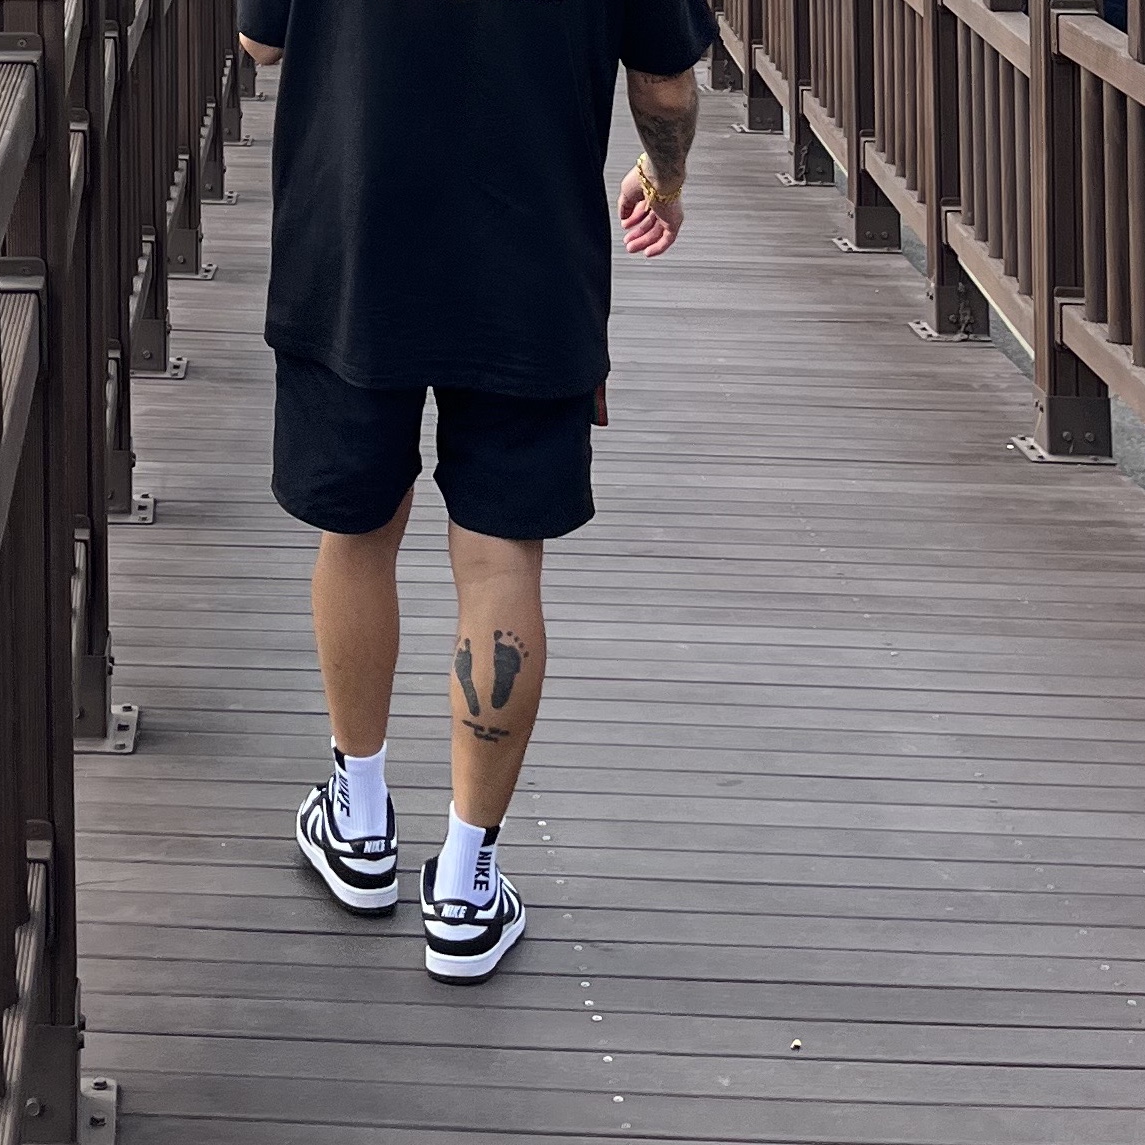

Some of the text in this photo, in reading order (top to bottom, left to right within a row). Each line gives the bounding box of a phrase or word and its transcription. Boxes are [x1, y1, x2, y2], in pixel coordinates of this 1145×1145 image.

[336, 770, 352, 817] NIKE
[363, 839, 386, 854] NIKE
[472, 850, 493, 893] NIKE
[441, 903, 467, 919] NIKE
